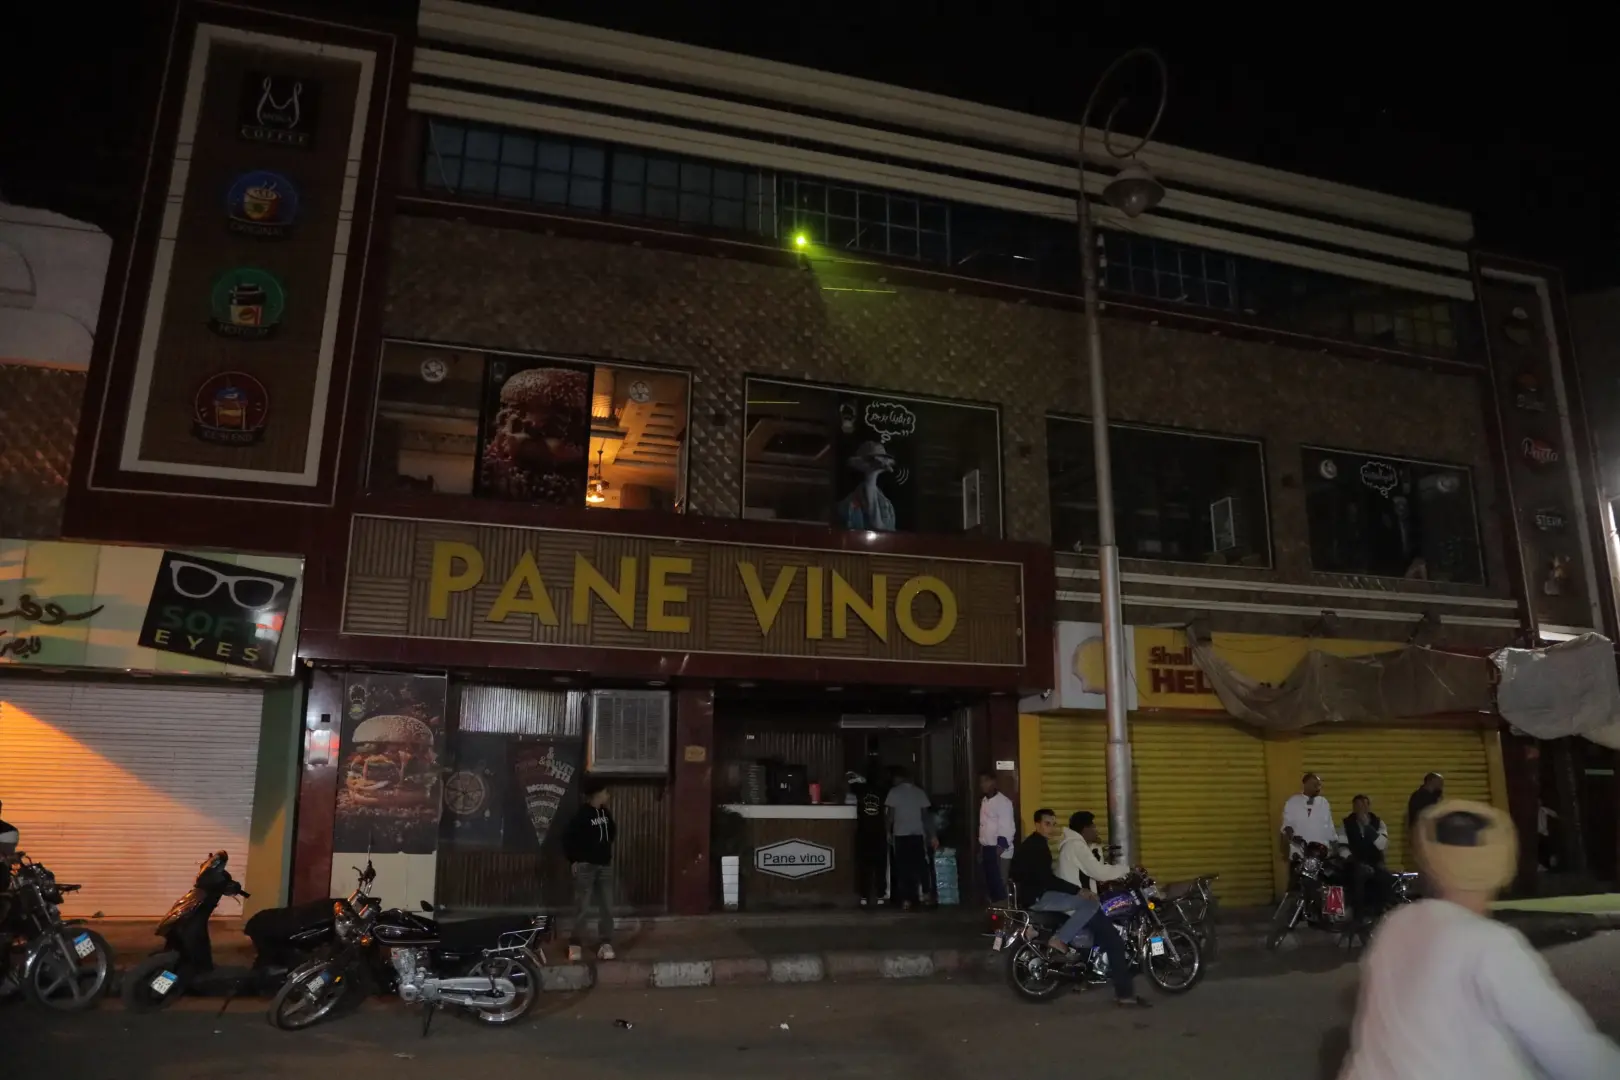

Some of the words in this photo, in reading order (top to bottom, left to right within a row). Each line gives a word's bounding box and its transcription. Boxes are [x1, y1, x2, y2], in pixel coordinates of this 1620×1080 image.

[428, 540, 692, 634] PANE
[736, 560, 959, 647] VINO
[154, 628, 260, 662] EYES
[763, 853, 796, 864] Pane
[799, 853, 826, 864] vino
